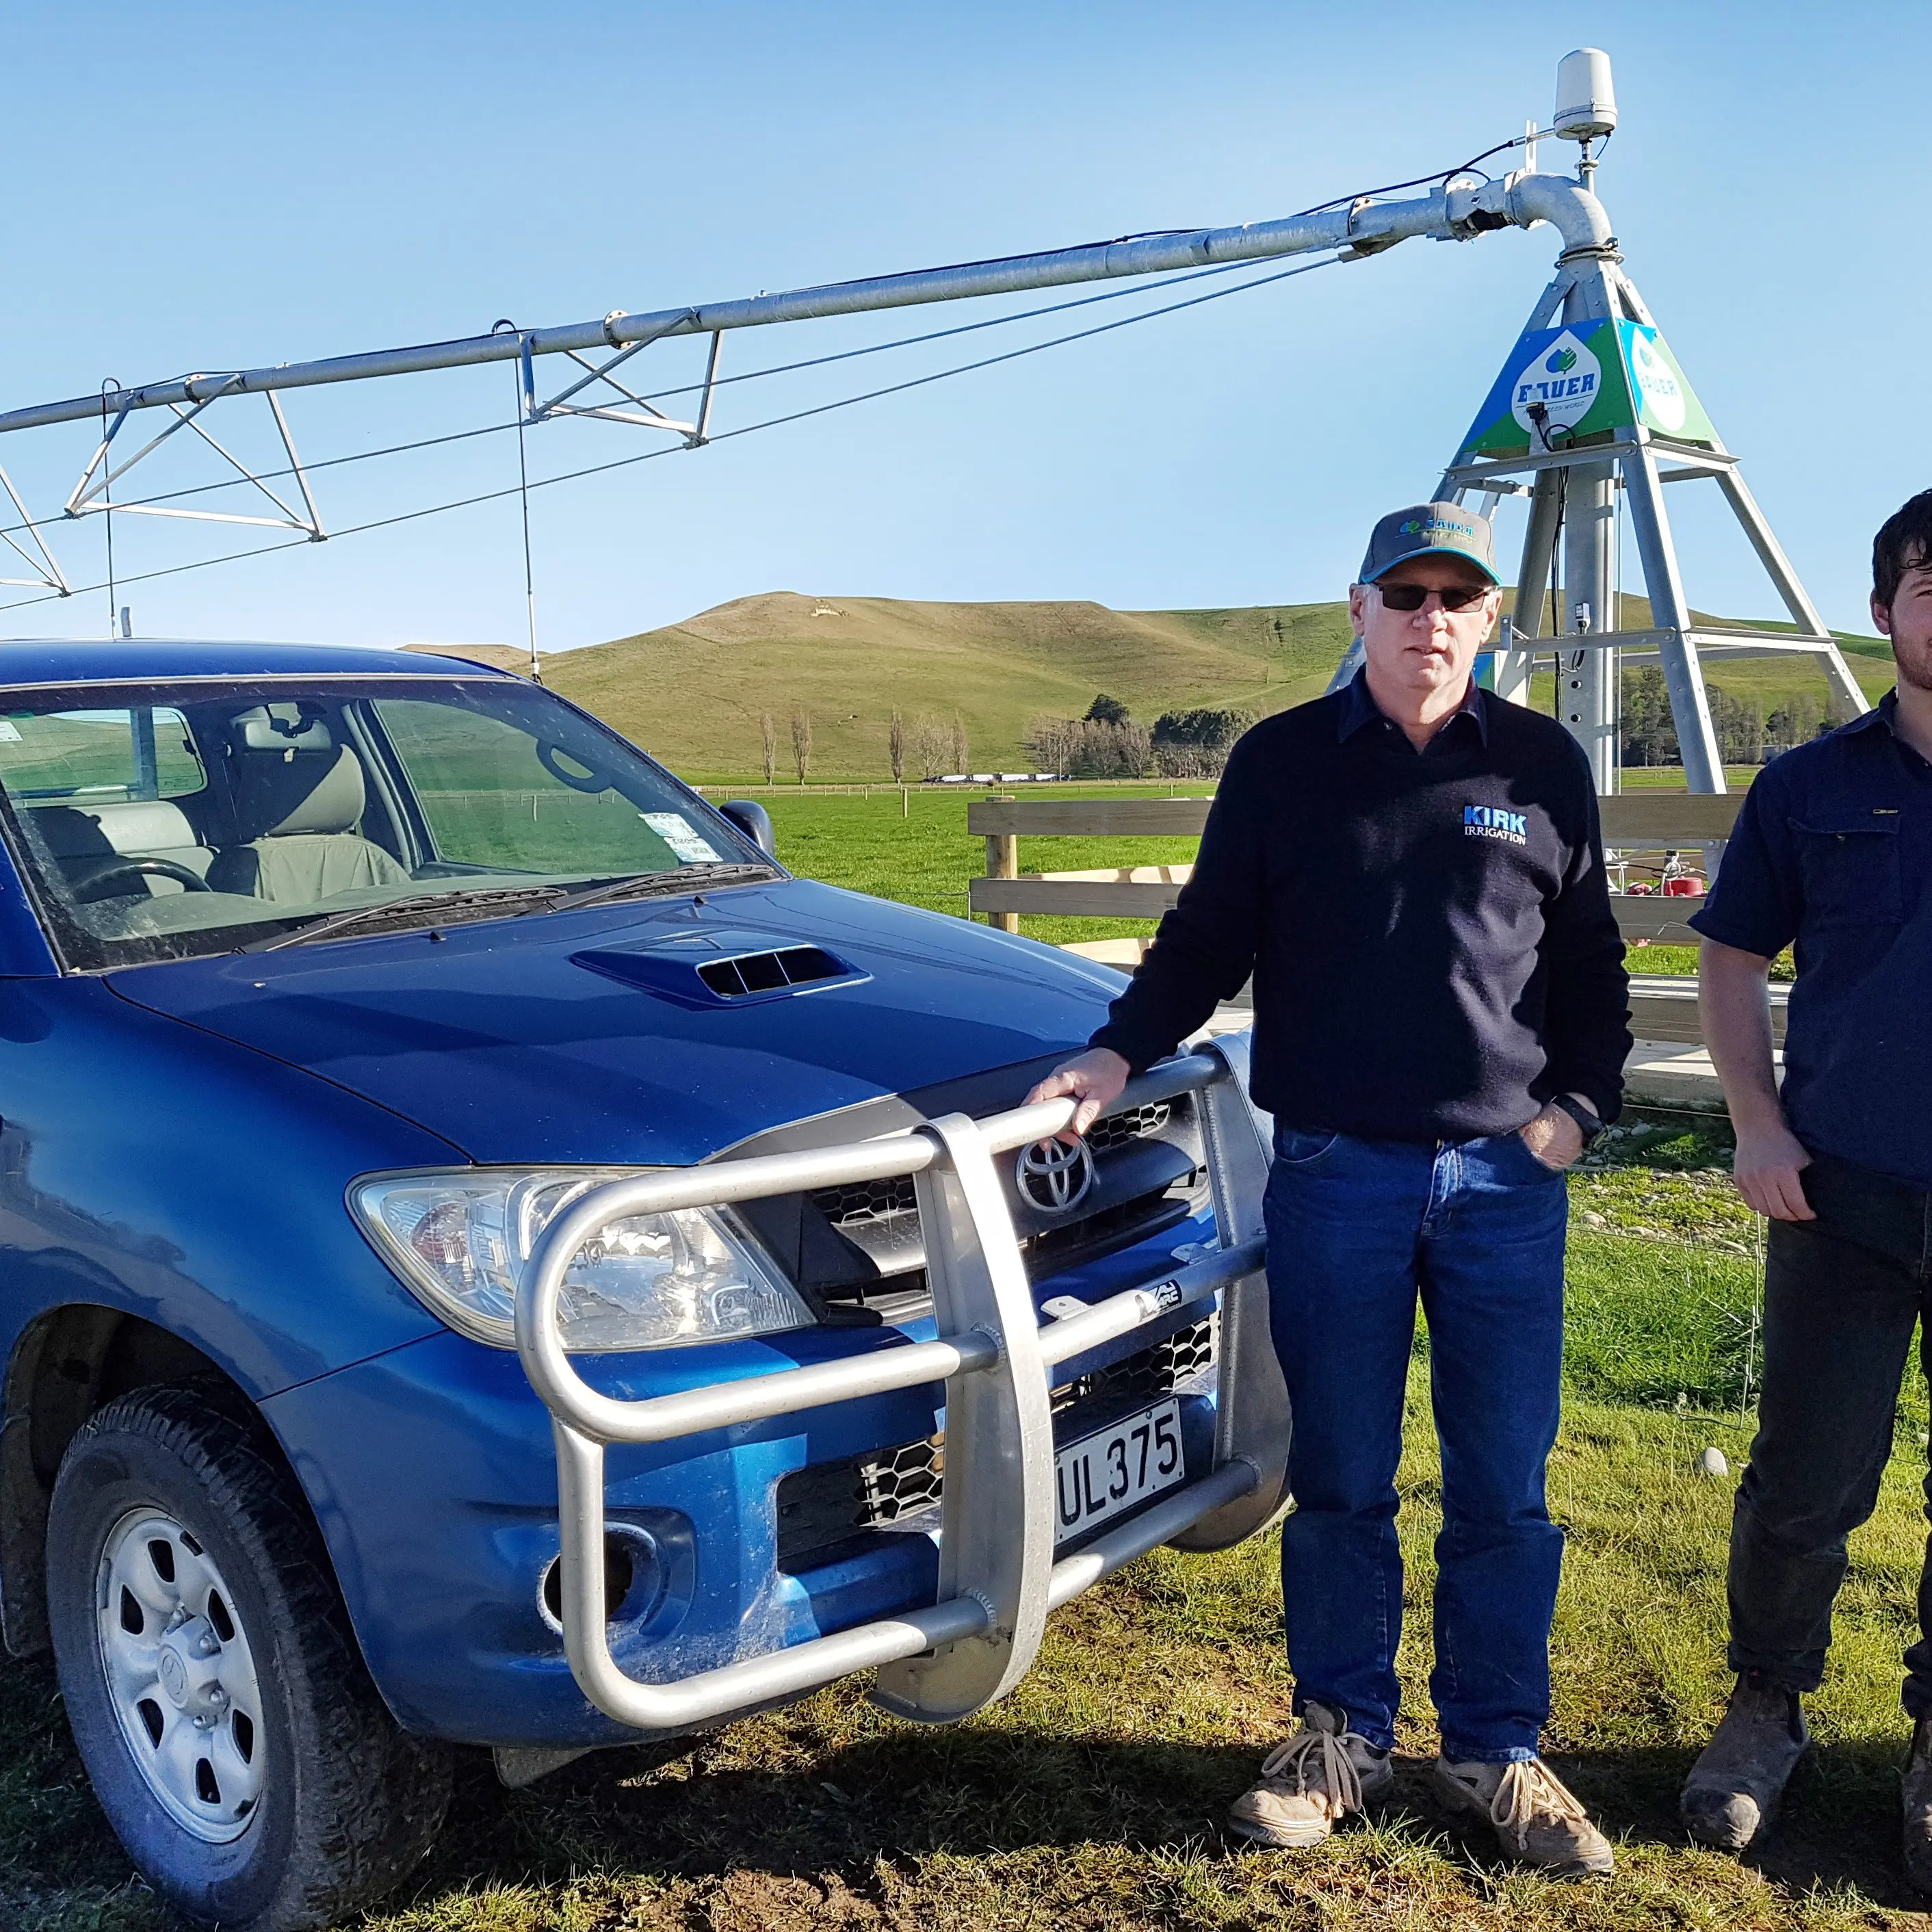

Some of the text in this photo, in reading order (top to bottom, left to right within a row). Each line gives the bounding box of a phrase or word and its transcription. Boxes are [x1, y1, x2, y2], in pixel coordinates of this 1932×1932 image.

[1464, 805, 1527, 835] KIRK
[1464, 826, 1526, 846] IRRIGATION
[1057, 1413, 1178, 1526] UL375
